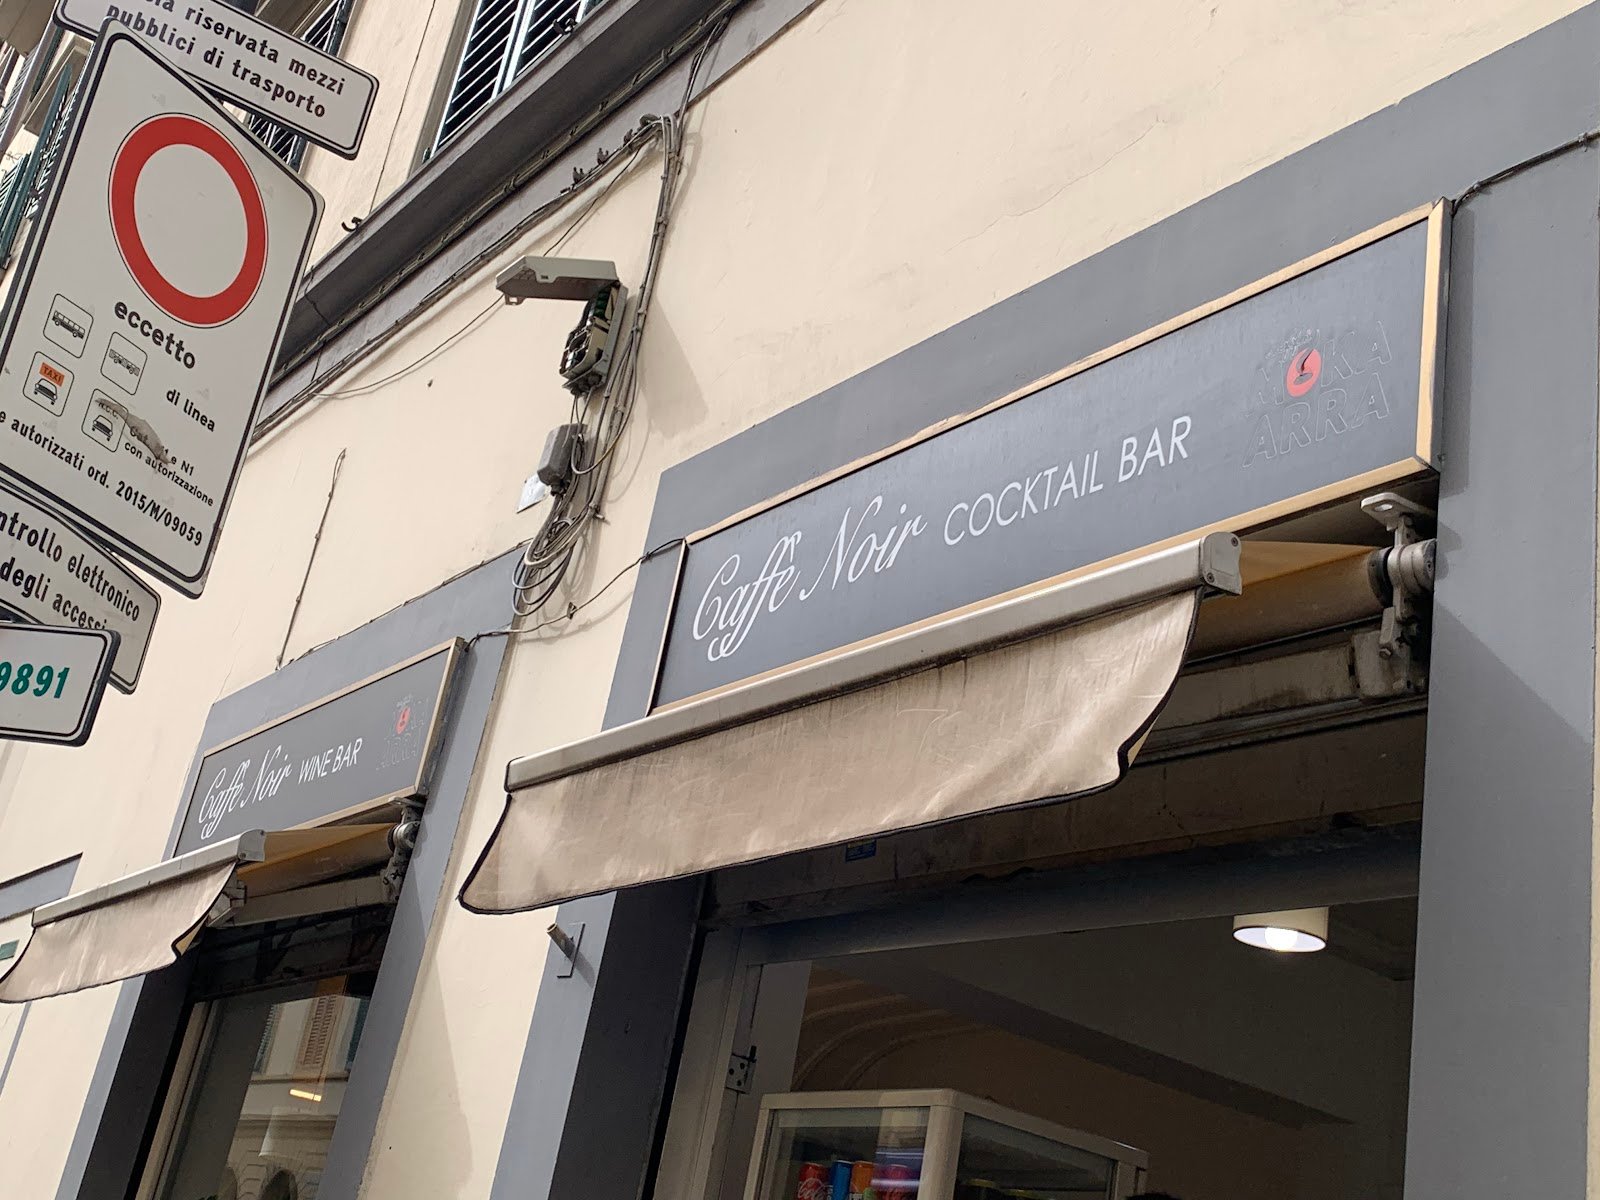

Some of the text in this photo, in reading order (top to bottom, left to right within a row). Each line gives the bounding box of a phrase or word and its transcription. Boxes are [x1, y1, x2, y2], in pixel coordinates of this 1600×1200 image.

[106, 5, 326, 118] pubblici di trasporto
[185, 7, 345, 95] riservata mezzi
[114, 302, 196, 369] eccetto
[43, 366, 62, 383] TAXI
[166, 388, 216, 432] di linea
[0, 411, 203, 546] e autorizzati ord. 2015/M/09059
[124, 442, 214, 506] con autorizzazione
[170, 456, 177, 465] e
[180, 460, 195, 476] N1
[799, 495, 928, 600] Noir
[943, 450, 1104, 546] COCKTAIL
[1118, 415, 1192, 483] BAR
[0, 556, 108, 630] degli acces
[67, 553, 141, 622] elettronico
[0, 661, 70, 699] 9891
[240, 745, 293, 806] Noir
[297, 749, 334, 785] WINE
[331, 738, 363, 775] BAR
